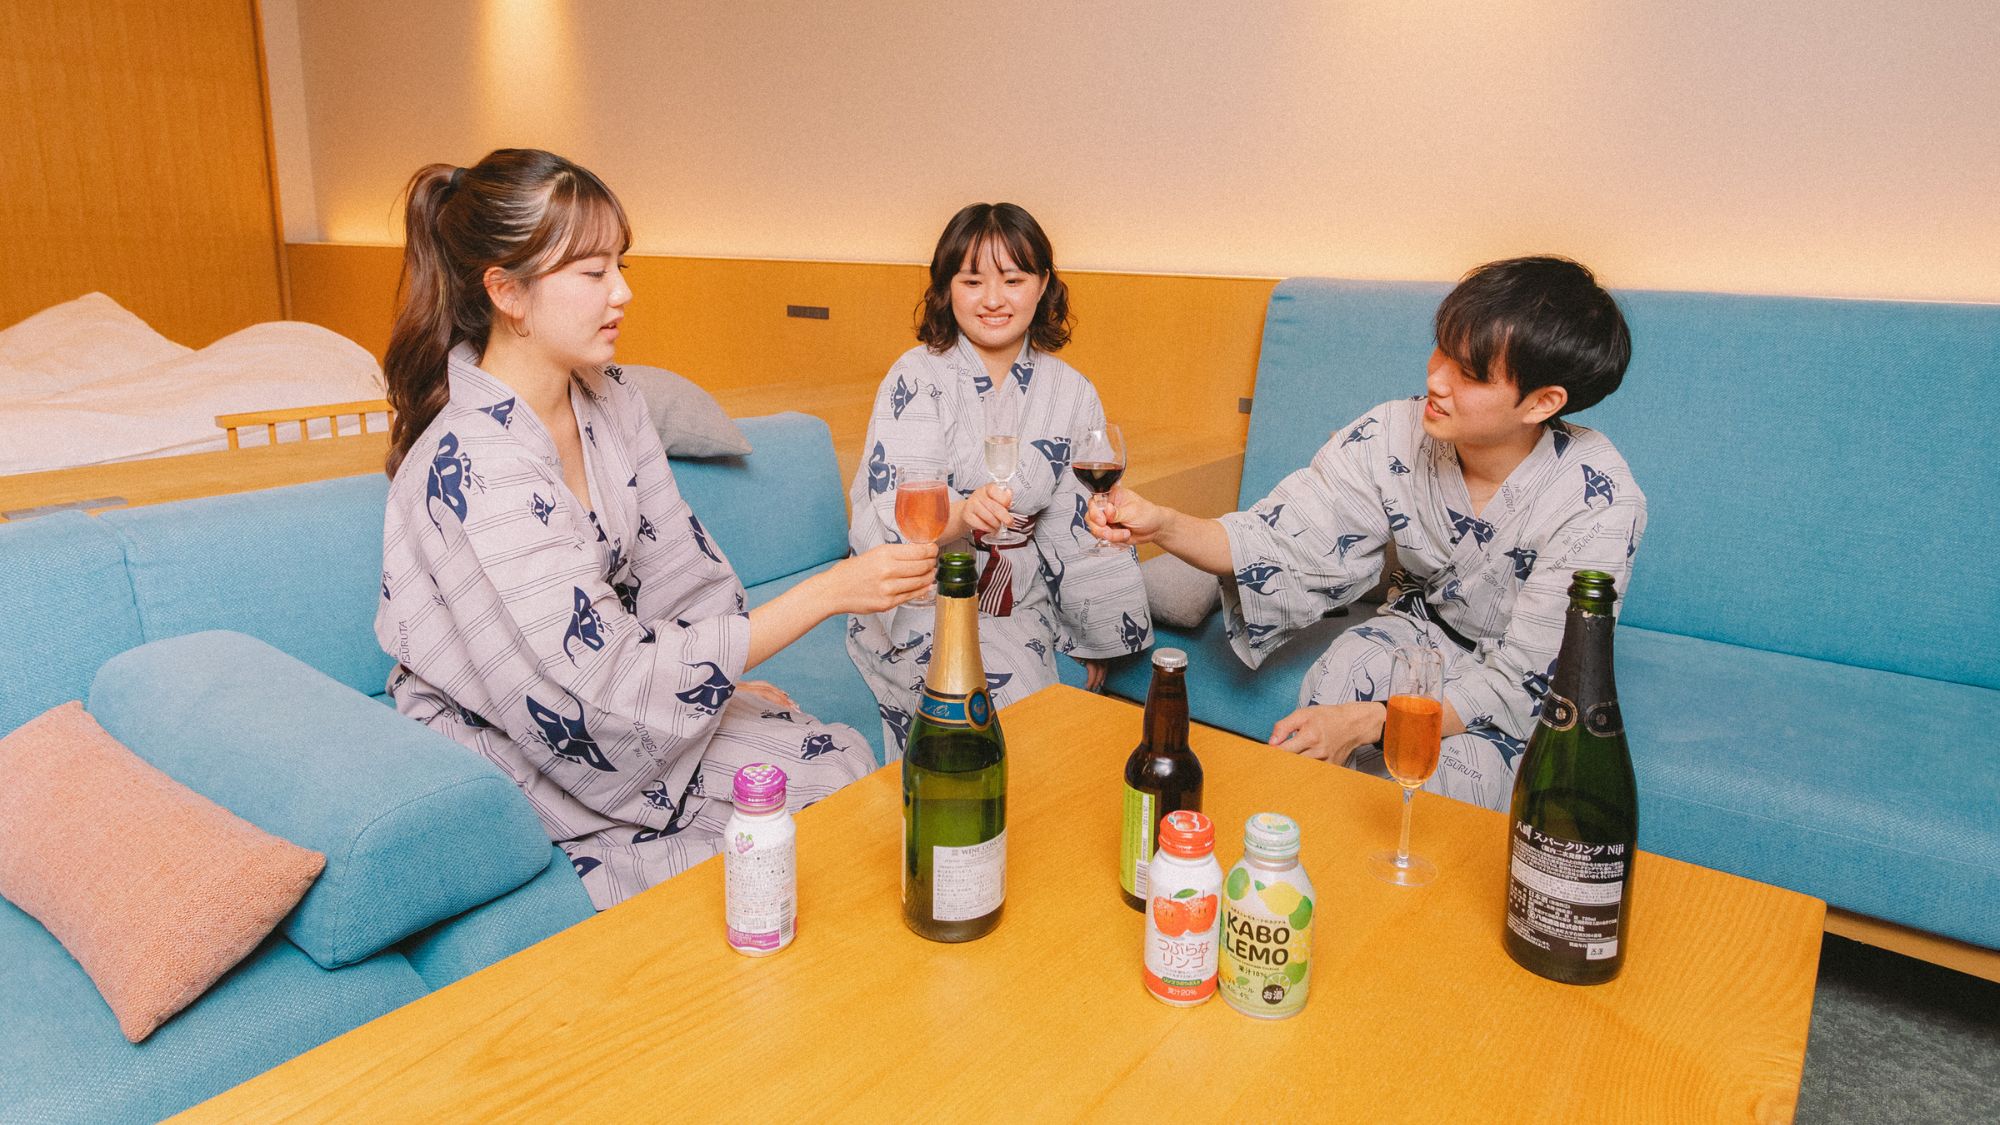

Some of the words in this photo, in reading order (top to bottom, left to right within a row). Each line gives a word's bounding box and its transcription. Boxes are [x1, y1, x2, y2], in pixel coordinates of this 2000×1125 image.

[1547, 554, 1568, 573] NEW
[1567, 521, 1604, 555] TSURUTA
[632, 720, 659, 757] TSURUTA
[1442, 754, 1483, 782] TSURUTA
[1533, 832, 1606, 856] スパークリング
[1606, 843, 1625, 856] Niji
[1227, 911, 1290, 946] KABO
[1157, 938, 1211, 957] つぶらな
[1162, 951, 1205, 969] リンゴ
[1226, 931, 1289, 967] LEMO
[1263, 989, 1284, 1001] お酒
